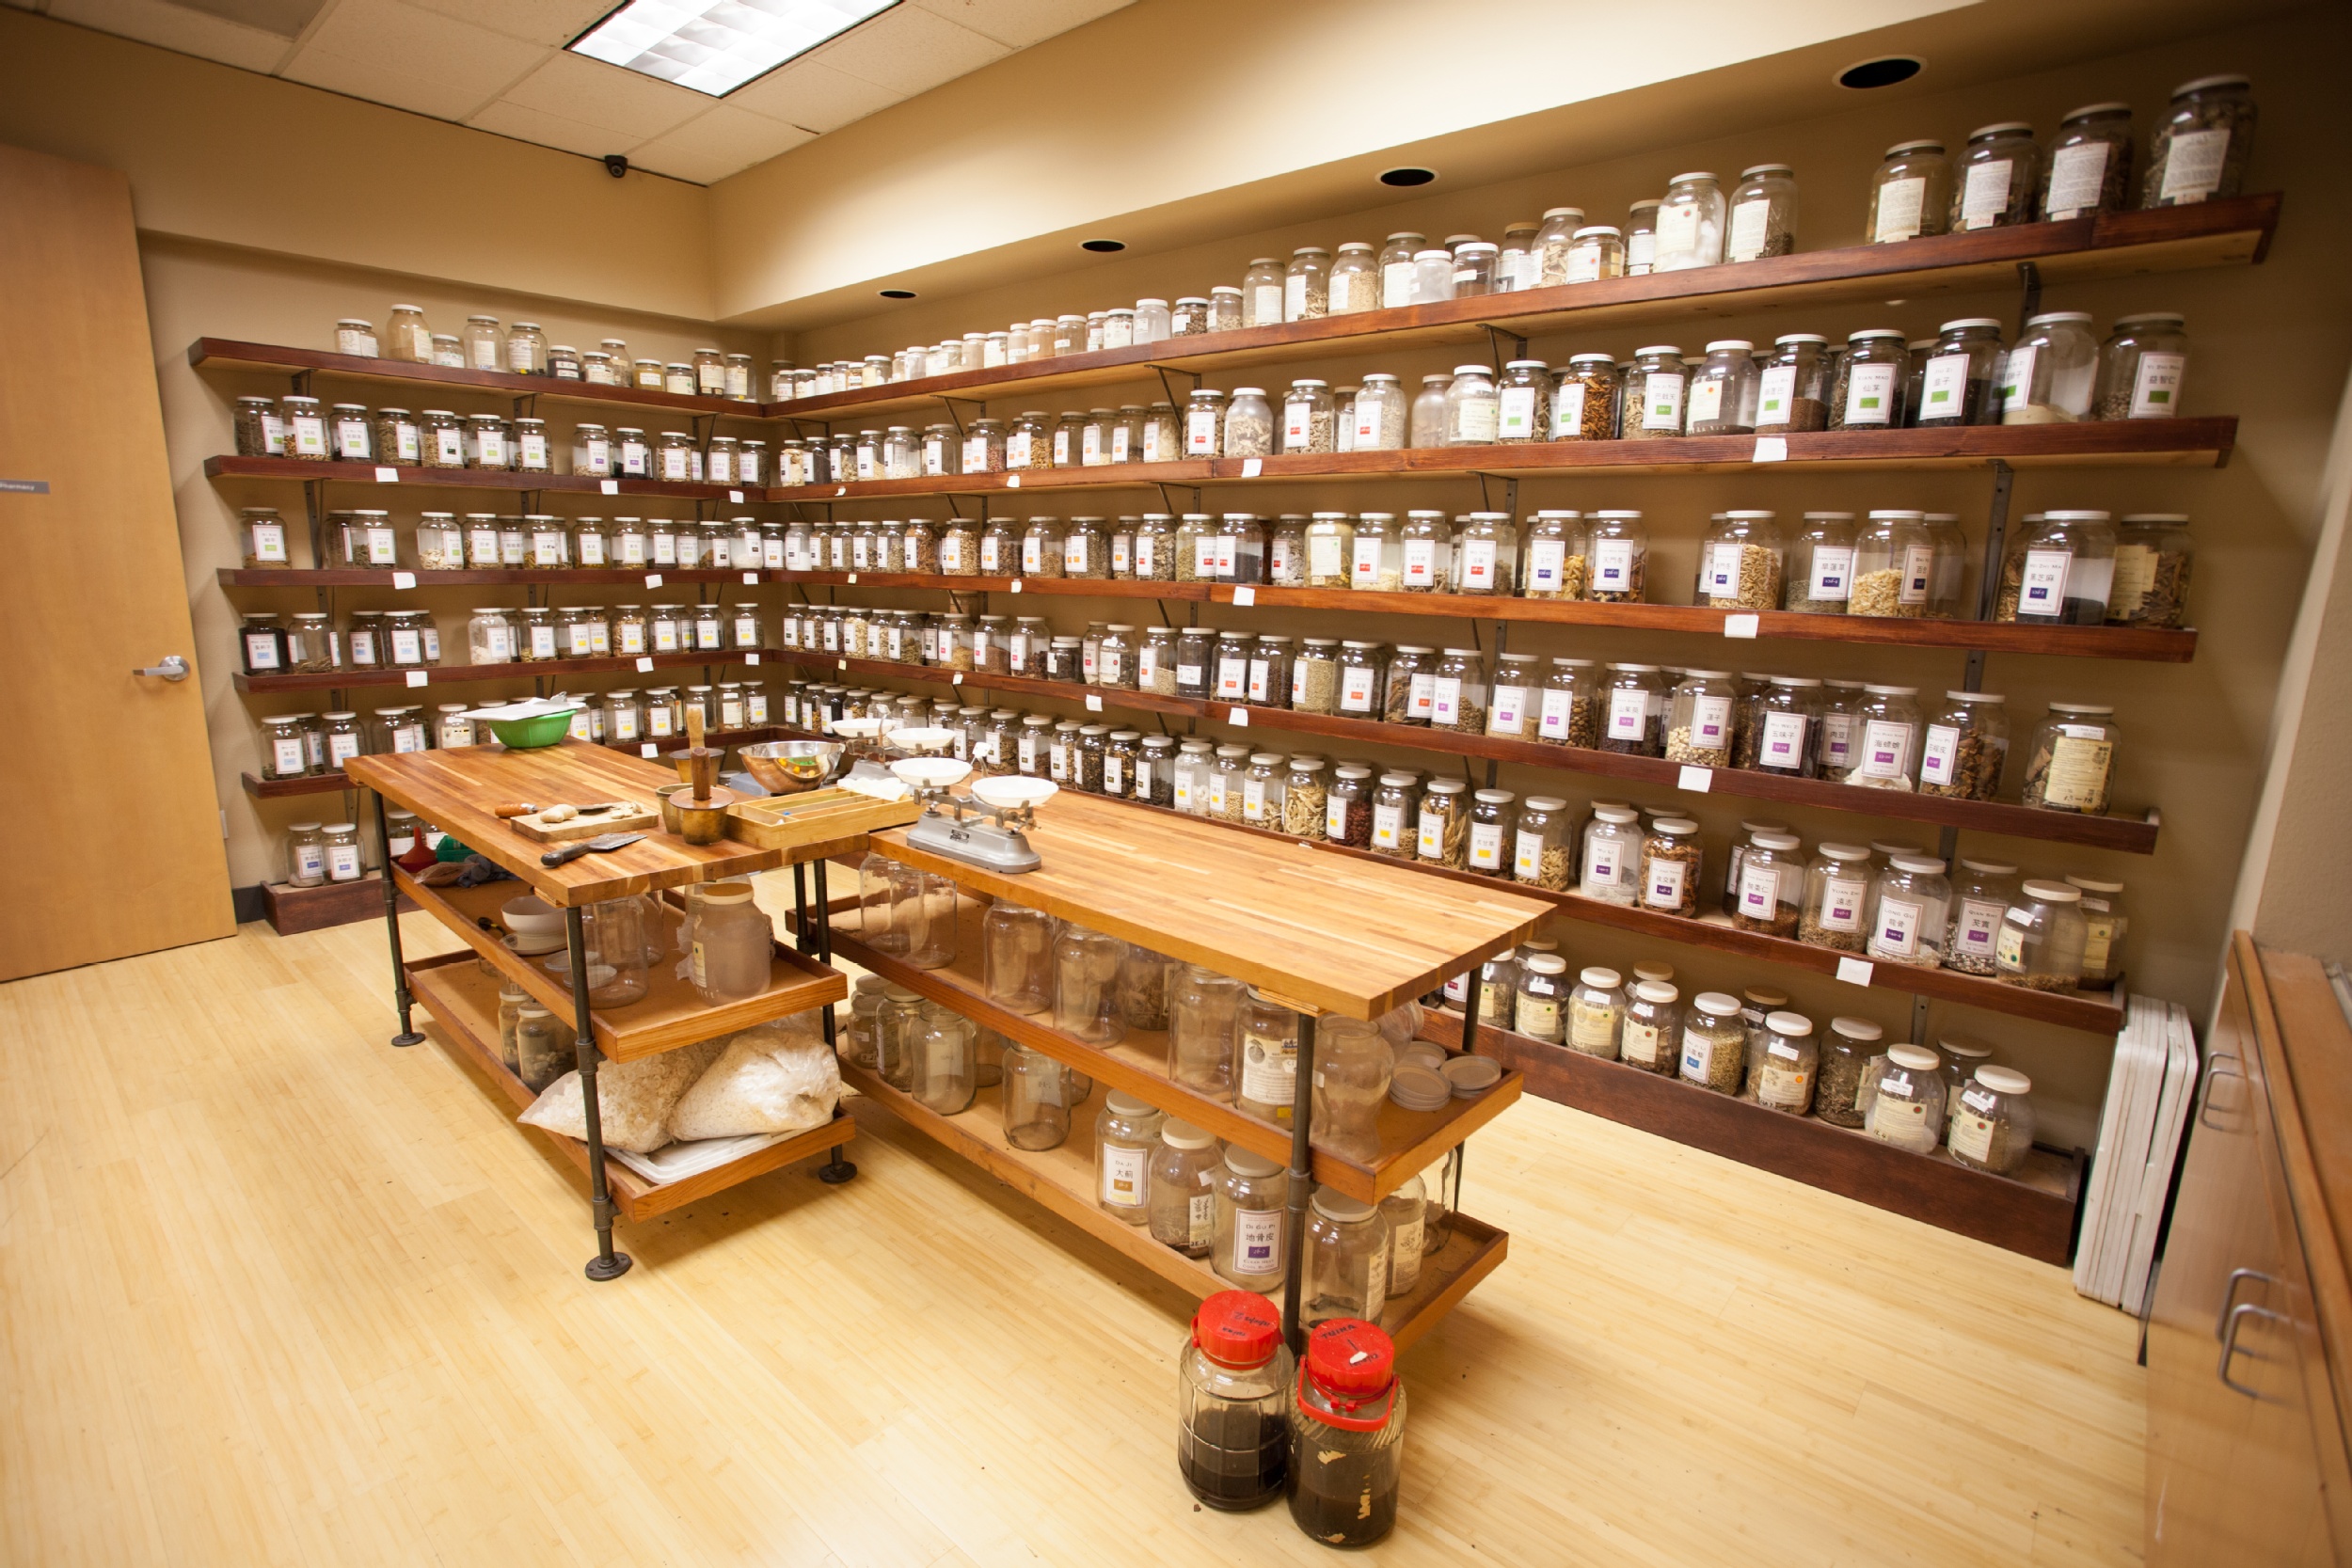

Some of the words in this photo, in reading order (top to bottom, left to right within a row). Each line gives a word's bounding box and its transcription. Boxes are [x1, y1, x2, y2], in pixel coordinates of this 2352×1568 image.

[2149, 375, 2176, 385] 益智仁
[1863, 384, 1880, 392] 仙茅
[1836, 897, 1853, 906] 遠志
[1884, 908, 1900, 916] LONG
[1246, 1232, 1275, 1242] 地骨皮
[1321, 1324, 1356, 1338] TUINA
